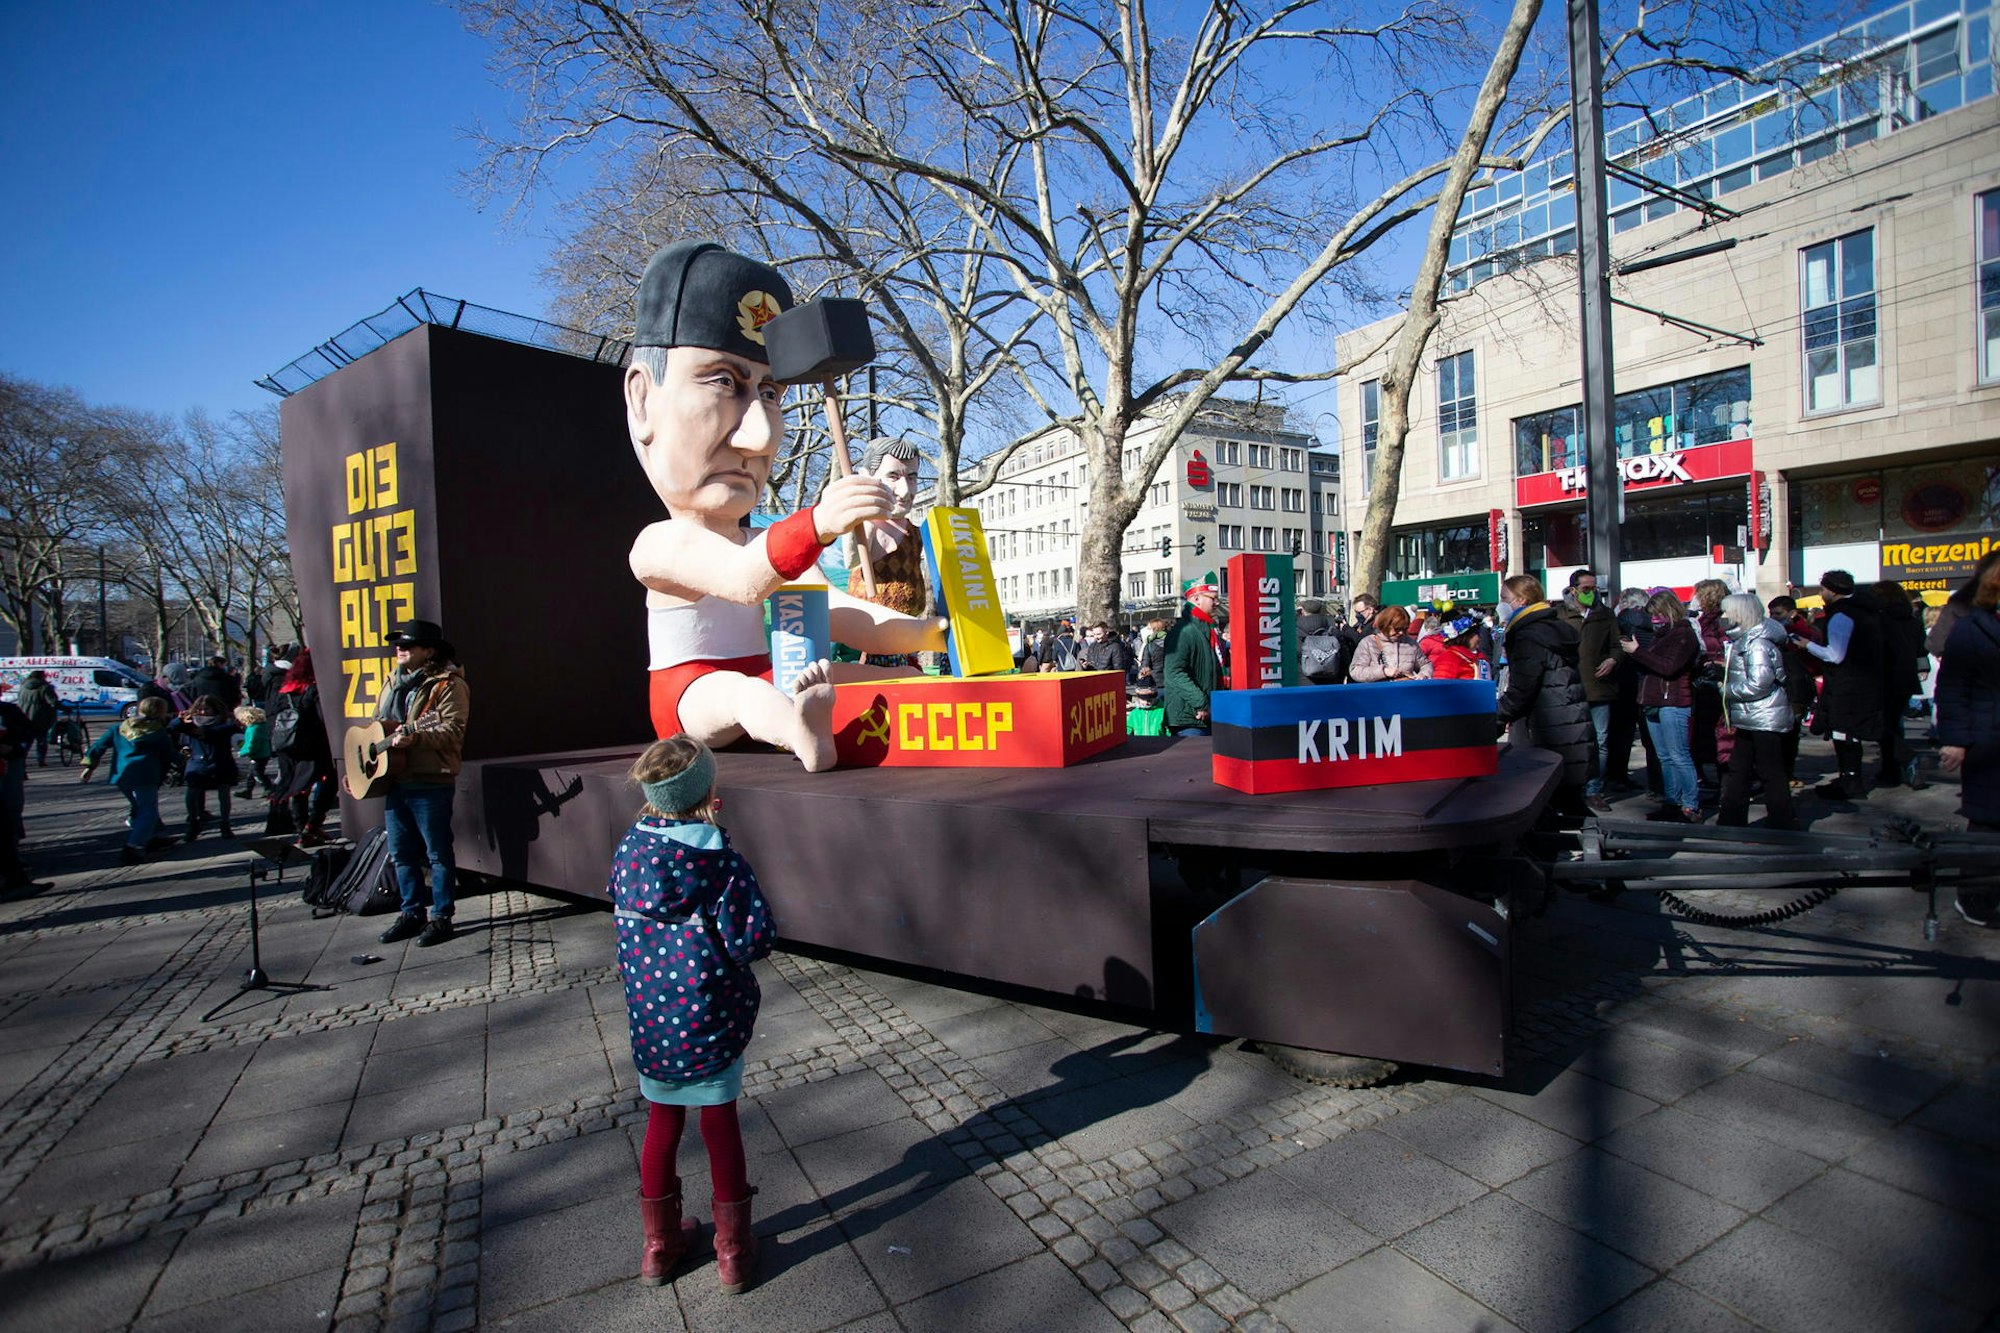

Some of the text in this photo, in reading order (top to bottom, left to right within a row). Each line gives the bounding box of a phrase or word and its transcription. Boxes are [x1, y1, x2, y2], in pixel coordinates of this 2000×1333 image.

[345, 442, 399, 516] DIE
[332, 509, 417, 583] GUTE
[949, 515, 990, 612] UKRAINE
[342, 657, 397, 718] ZE
[1298, 714, 1402, 764] KRIM
